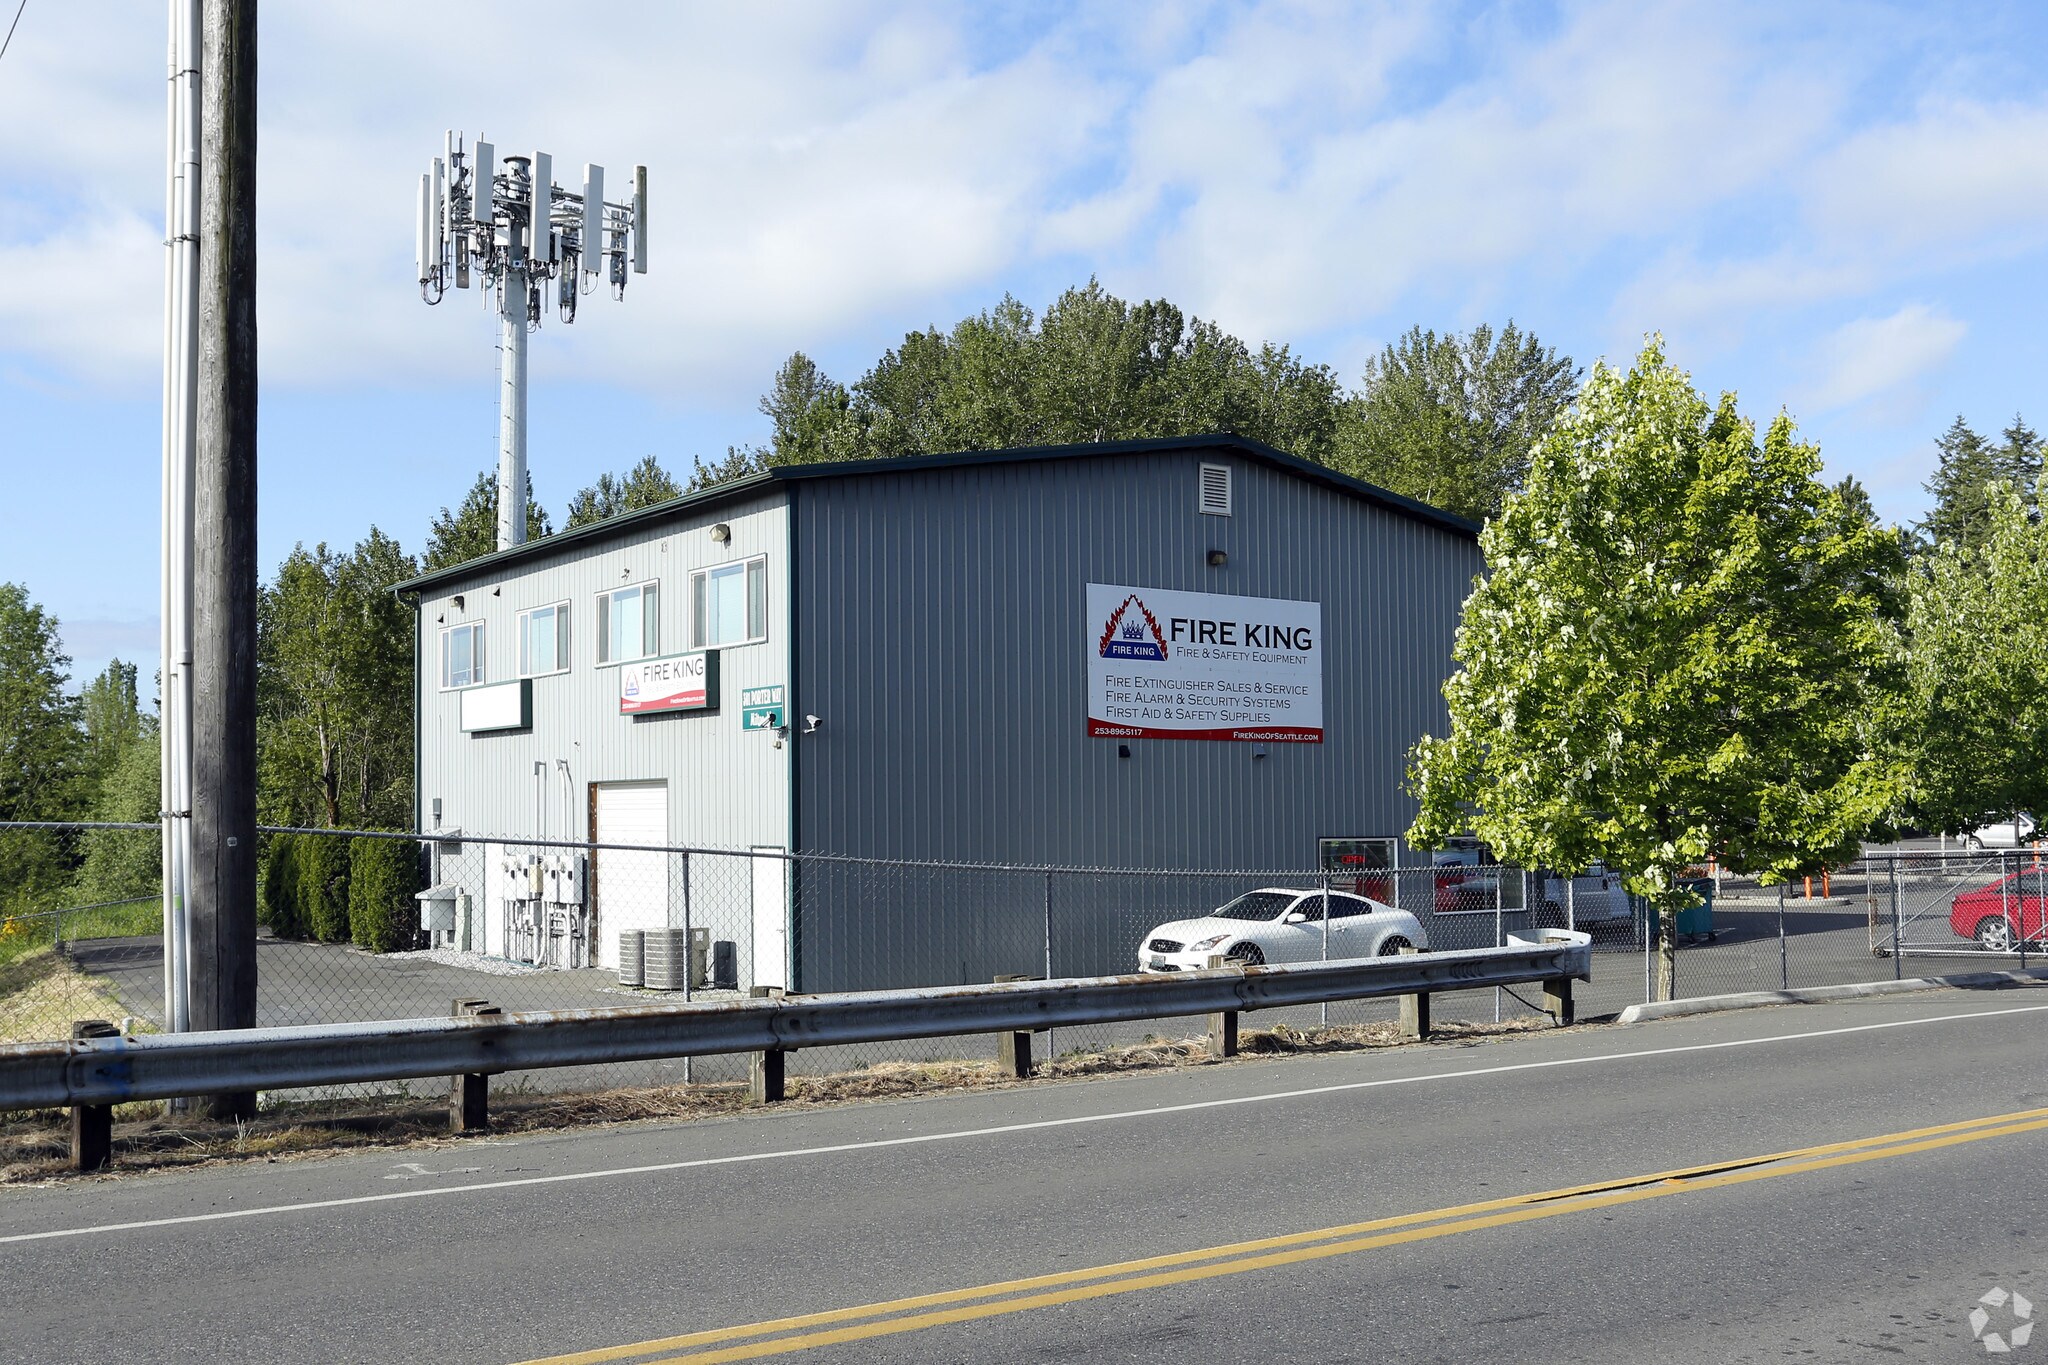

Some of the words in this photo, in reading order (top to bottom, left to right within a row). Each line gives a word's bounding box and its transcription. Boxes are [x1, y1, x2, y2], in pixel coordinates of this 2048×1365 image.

[1170, 617, 1237, 646] FIRE
[1245, 623, 1313, 651] KING
[1112, 645, 1132, 655] FIRE
[1133, 646, 1155, 656] KING
[1202, 648, 1210, 658] &
[643, 663, 670, 683] FIRE
[673, 658, 704, 679] KING
[1254, 682, 1263, 693] &
[1176, 694, 1185, 705] &
[1164, 708, 1173, 719] &
[1341, 854, 1366, 864] OPEN
